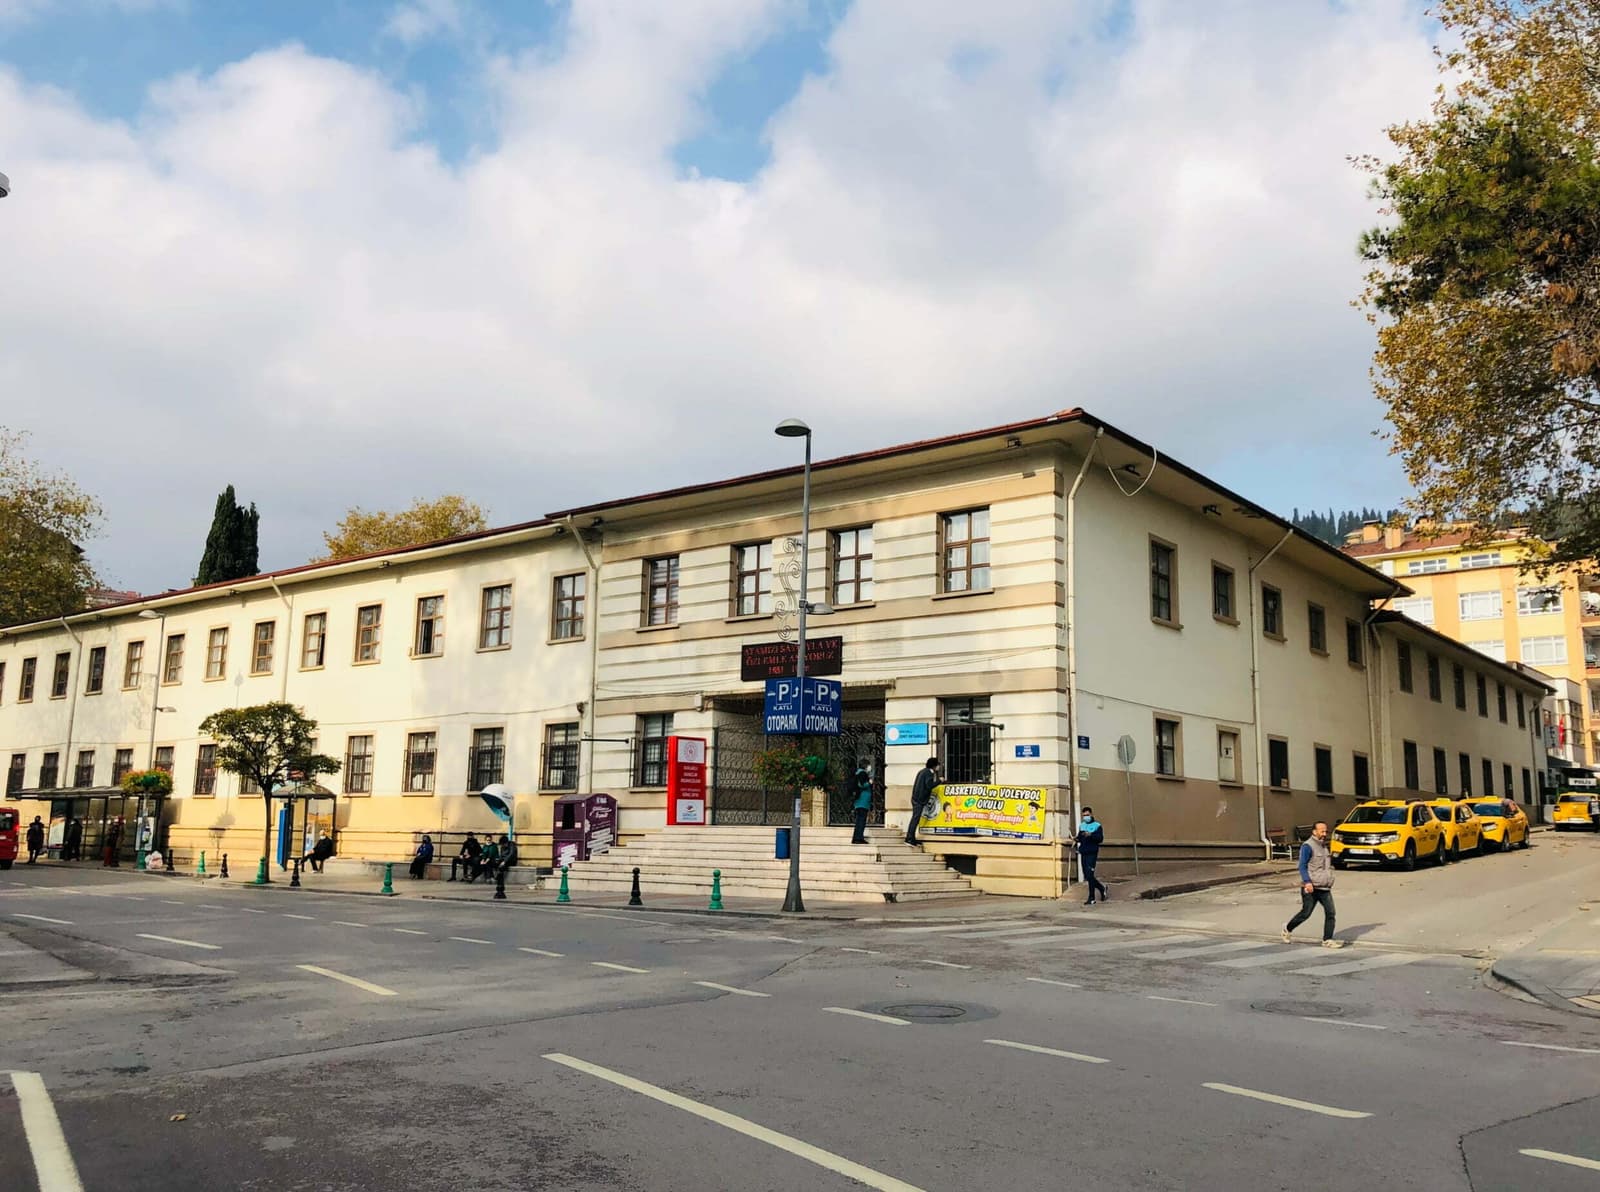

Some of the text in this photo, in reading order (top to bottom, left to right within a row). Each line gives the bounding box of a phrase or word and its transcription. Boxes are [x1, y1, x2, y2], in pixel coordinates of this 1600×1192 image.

[778, 684, 789, 702] P
[817, 684, 829, 702] P
[767, 714, 798, 731] OTOPARK
[805, 715, 838, 733] OTOPARK
[945, 786, 987, 796] BASKETBOL
[999, 788, 1040, 800] VOLEYBOL
[977, 799, 1004, 811] OKULU
